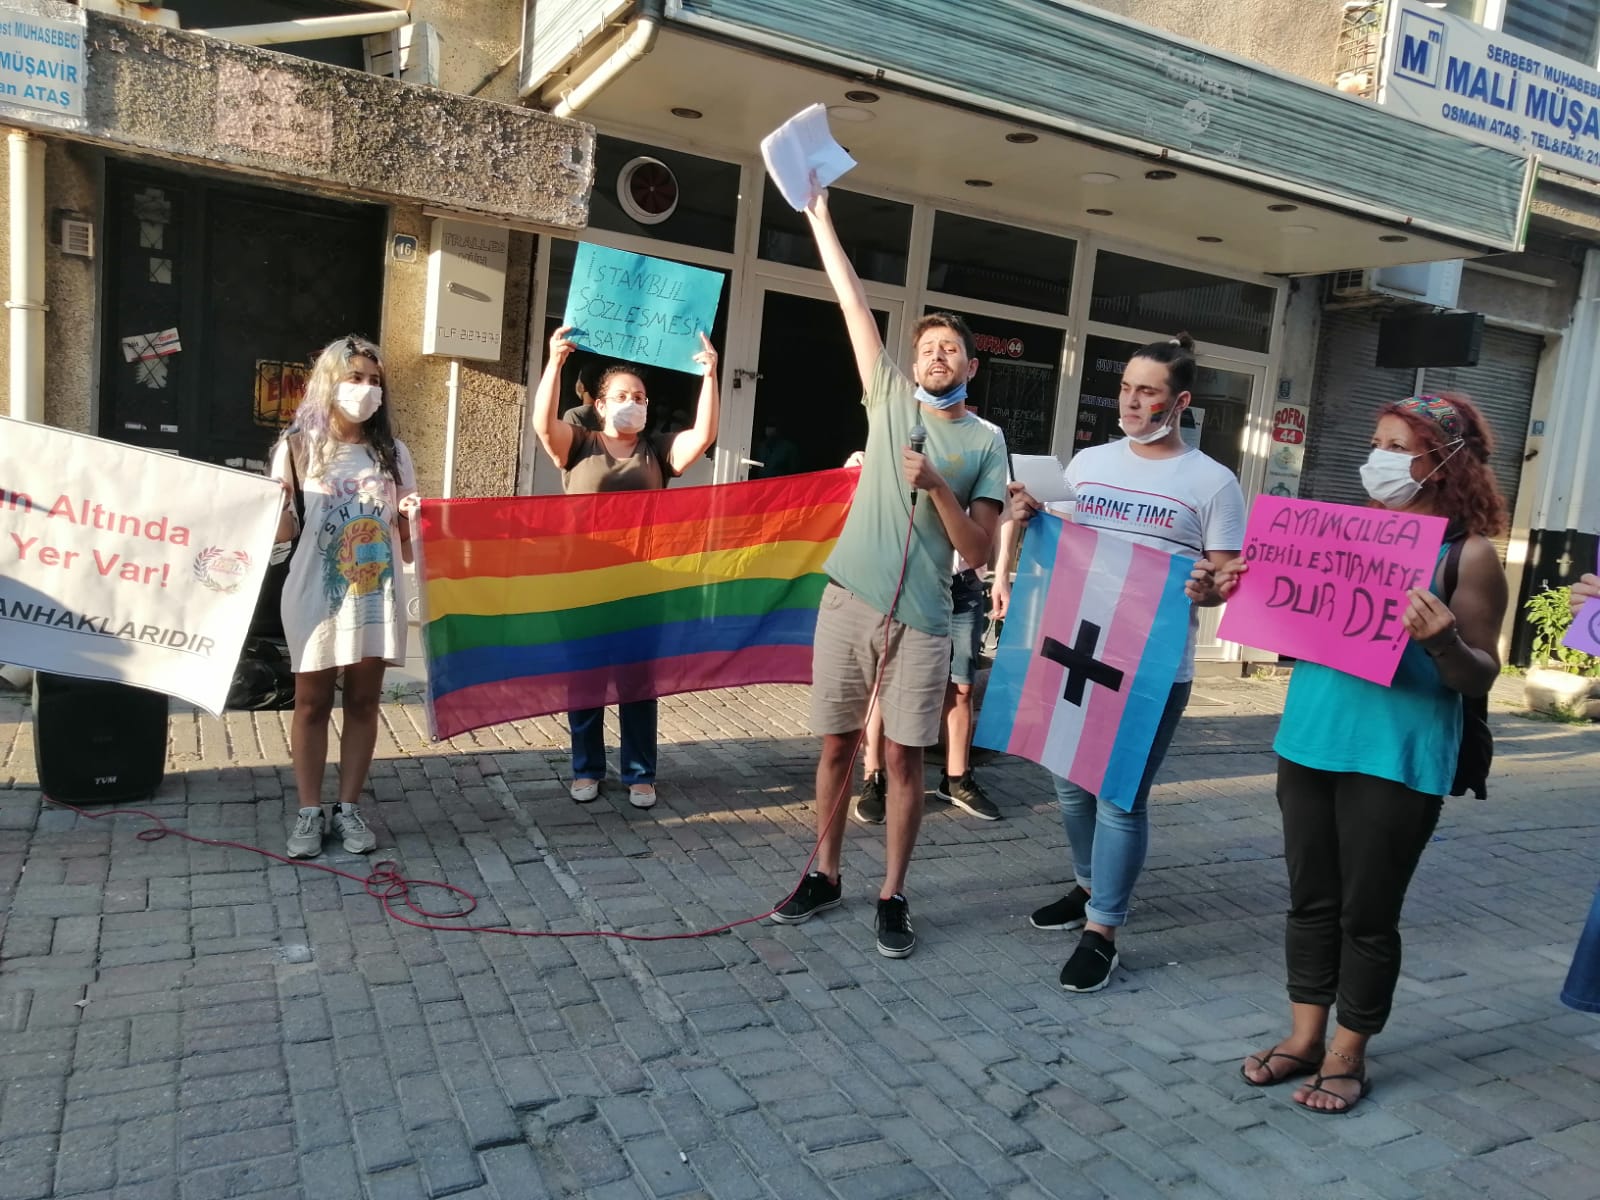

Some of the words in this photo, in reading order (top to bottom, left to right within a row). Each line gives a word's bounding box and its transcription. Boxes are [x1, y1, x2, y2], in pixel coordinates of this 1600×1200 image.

[0, 50, 78, 84] MÜŞAVİR
[1487, 43, 1541, 77] SERBEST
[24, 84, 71, 109] ATAŞ
[1445, 55, 1518, 112] MALİ
[1441, 103, 1487, 131] OSMAN
[1530, 131, 1585, 162] TEL&FAX:
[1586, 149, 1600, 168] 21
[399, 242, 412, 256] 16
[1274, 407, 1305, 434] SOFRA
[1280, 429, 1296, 442] 44
[47, 494, 191, 547] Altında
[1135, 503, 1178, 529] TIME
[10, 532, 80, 570] Yer
[92, 549, 171, 588] Var!
[1265, 575, 1337, 623] DUR
